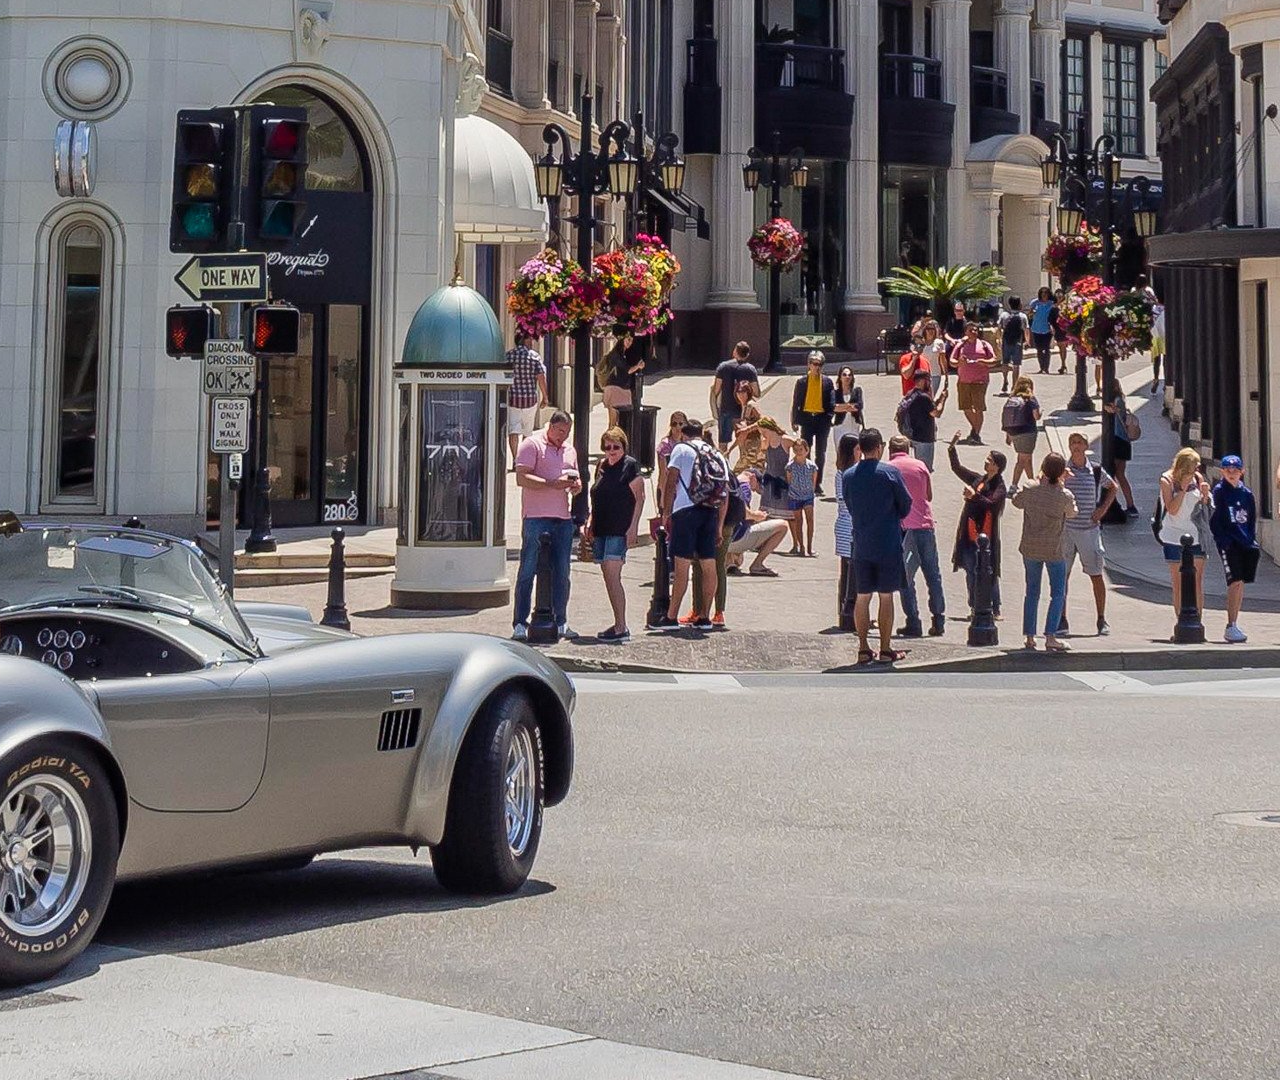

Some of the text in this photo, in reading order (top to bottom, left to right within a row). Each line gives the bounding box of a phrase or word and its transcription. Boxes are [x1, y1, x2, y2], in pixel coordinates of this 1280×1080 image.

[201, 268, 257, 287] ONE WAY
[207, 342, 245, 353] DIAGON
[206, 355, 254, 365] CROSSING
[206, 371, 223, 389] OK
[420, 371, 487, 379] TWO RODEO DRIVE
[217, 402, 245, 410] CROSS
[225, 421, 237, 429] ON
[219, 430, 241, 438] WALK
[215, 439, 244, 447] SIGNAL
[324, 504, 346, 521] 280
[6, 756, 66, 788] Radial
